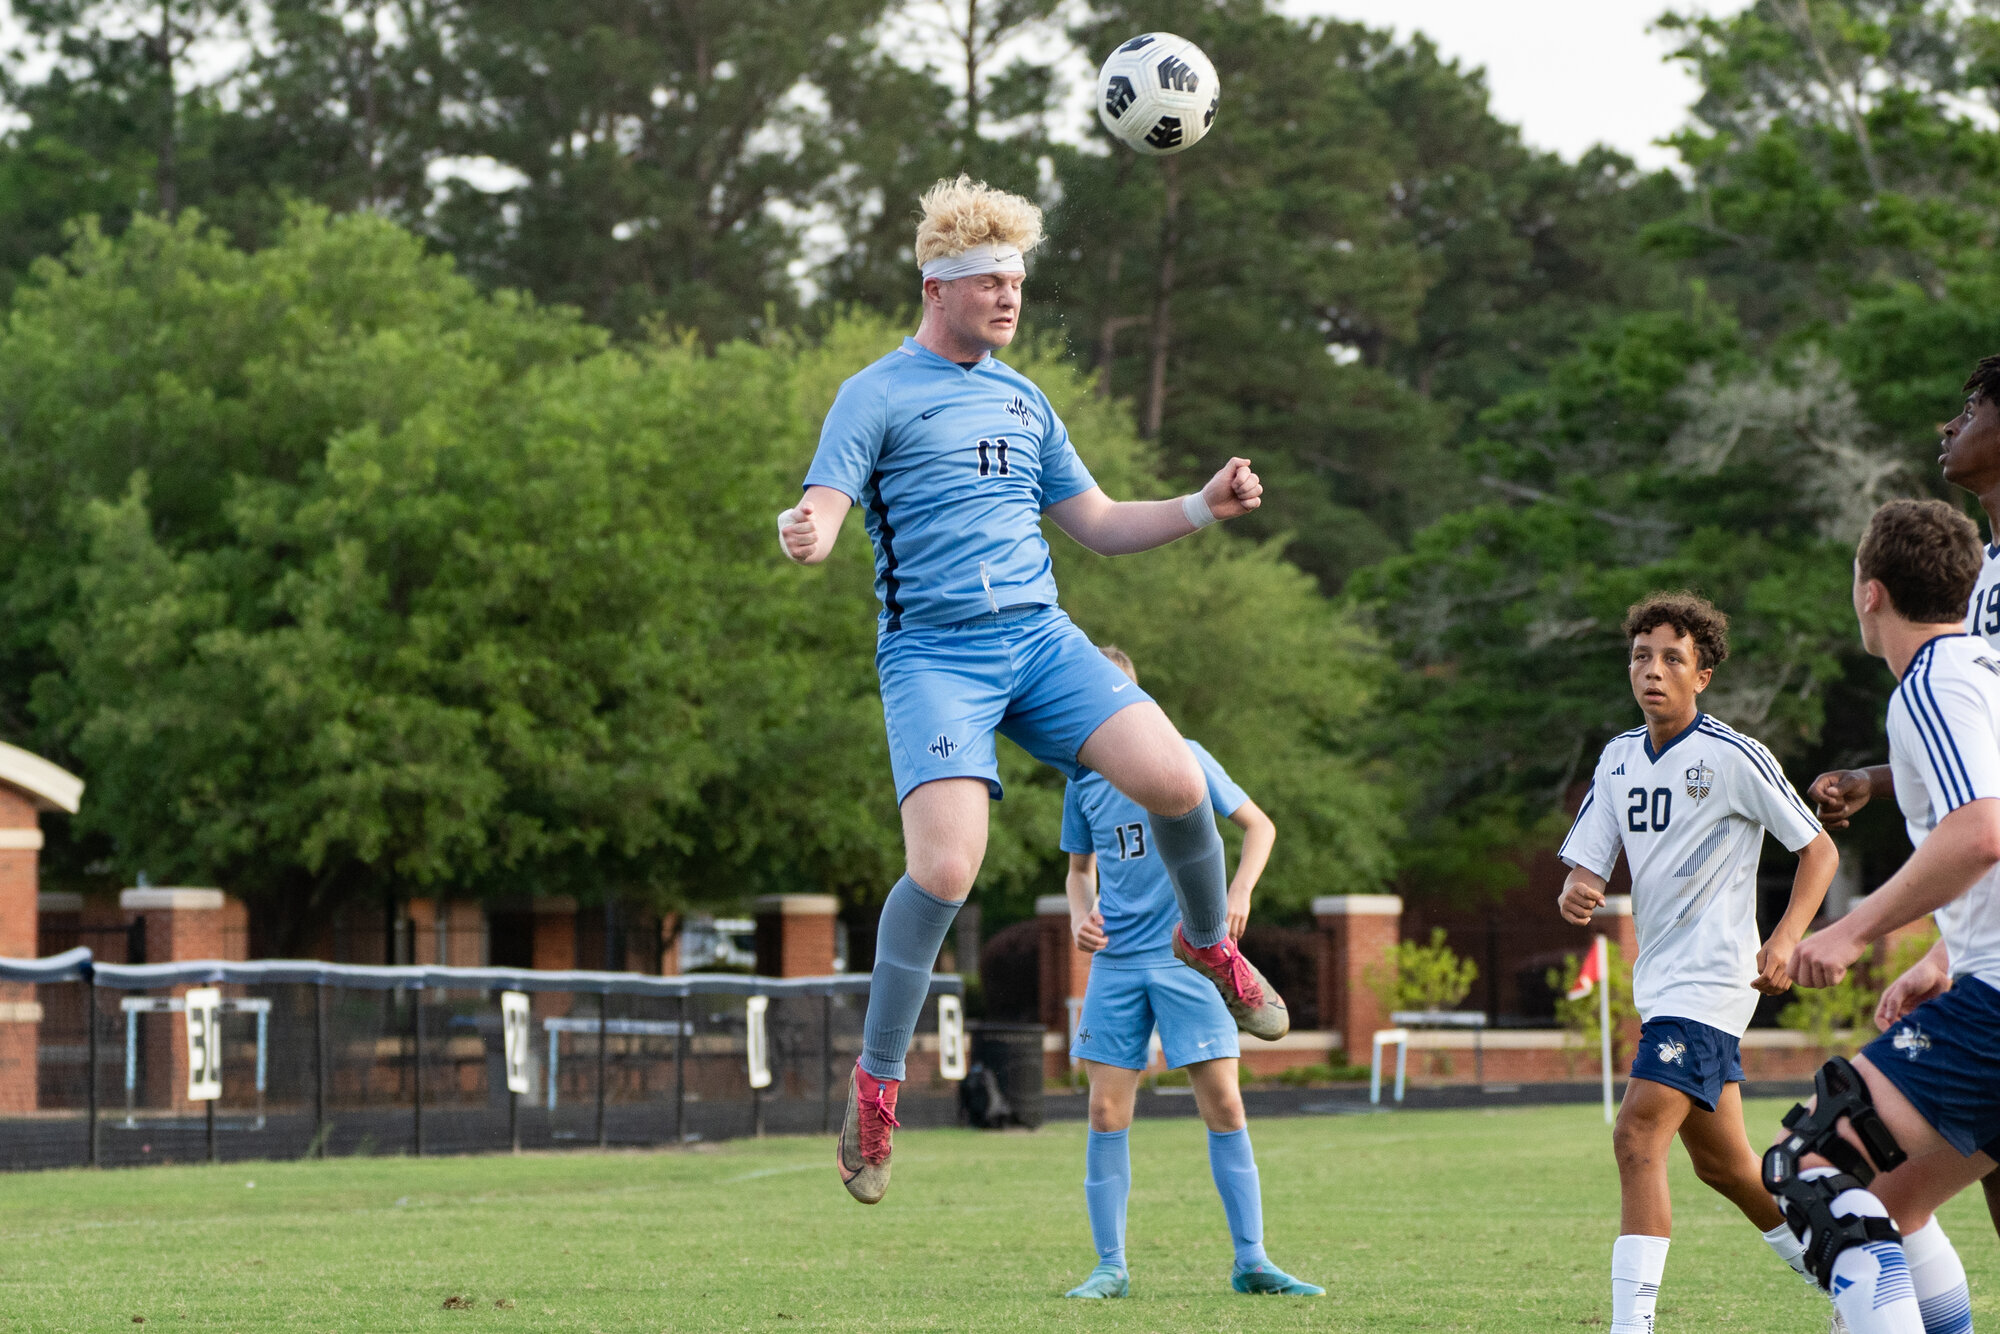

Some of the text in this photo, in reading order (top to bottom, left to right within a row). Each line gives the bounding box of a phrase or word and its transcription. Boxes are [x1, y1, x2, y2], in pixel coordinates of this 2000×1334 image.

[977, 437, 1010, 477] 11
[1627, 786, 1673, 833] 20
[1114, 821, 1147, 861] 13
